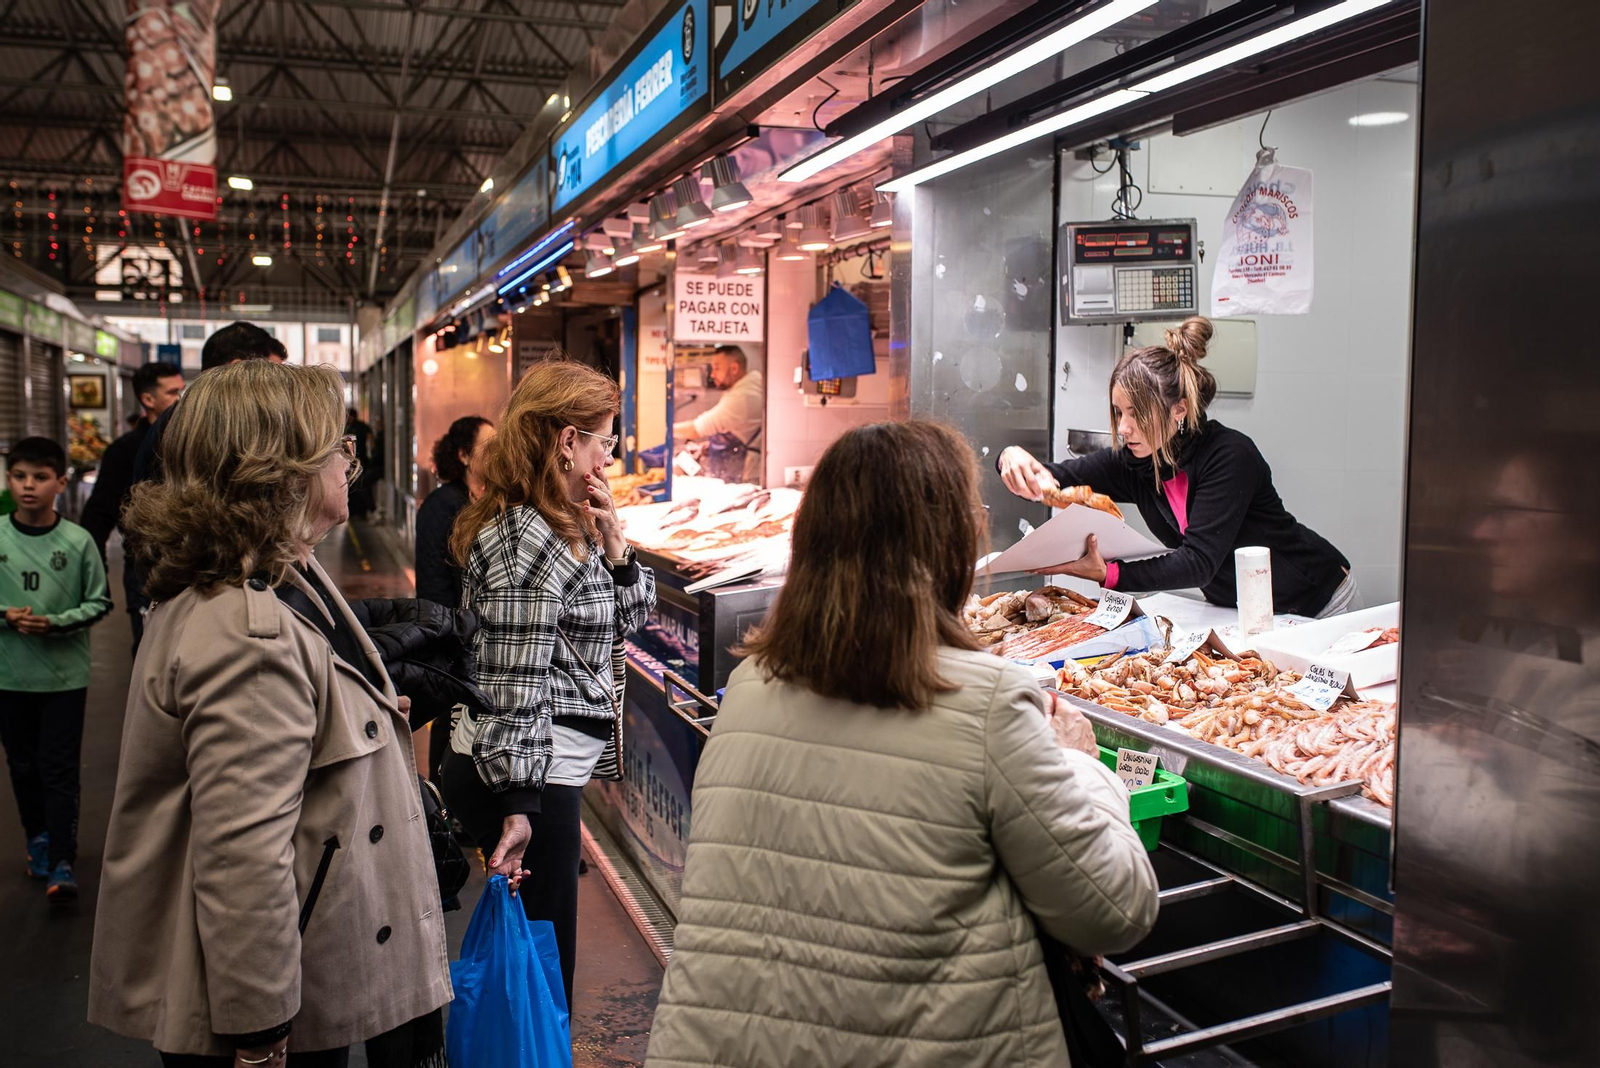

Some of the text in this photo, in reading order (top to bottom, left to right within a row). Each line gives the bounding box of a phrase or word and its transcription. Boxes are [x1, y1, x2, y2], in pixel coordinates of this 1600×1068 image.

[634, 49, 673, 115] FERRER
[1259, 186, 1299, 219] MARISCOS
[686, 281, 754, 297] SE PUEDE
[679, 300, 760, 316] PAGAR CON
[690, 320, 750, 334] TARJETA
[21, 571, 40, 591] 10
[1310, 664, 1335, 679] COLAS DE
